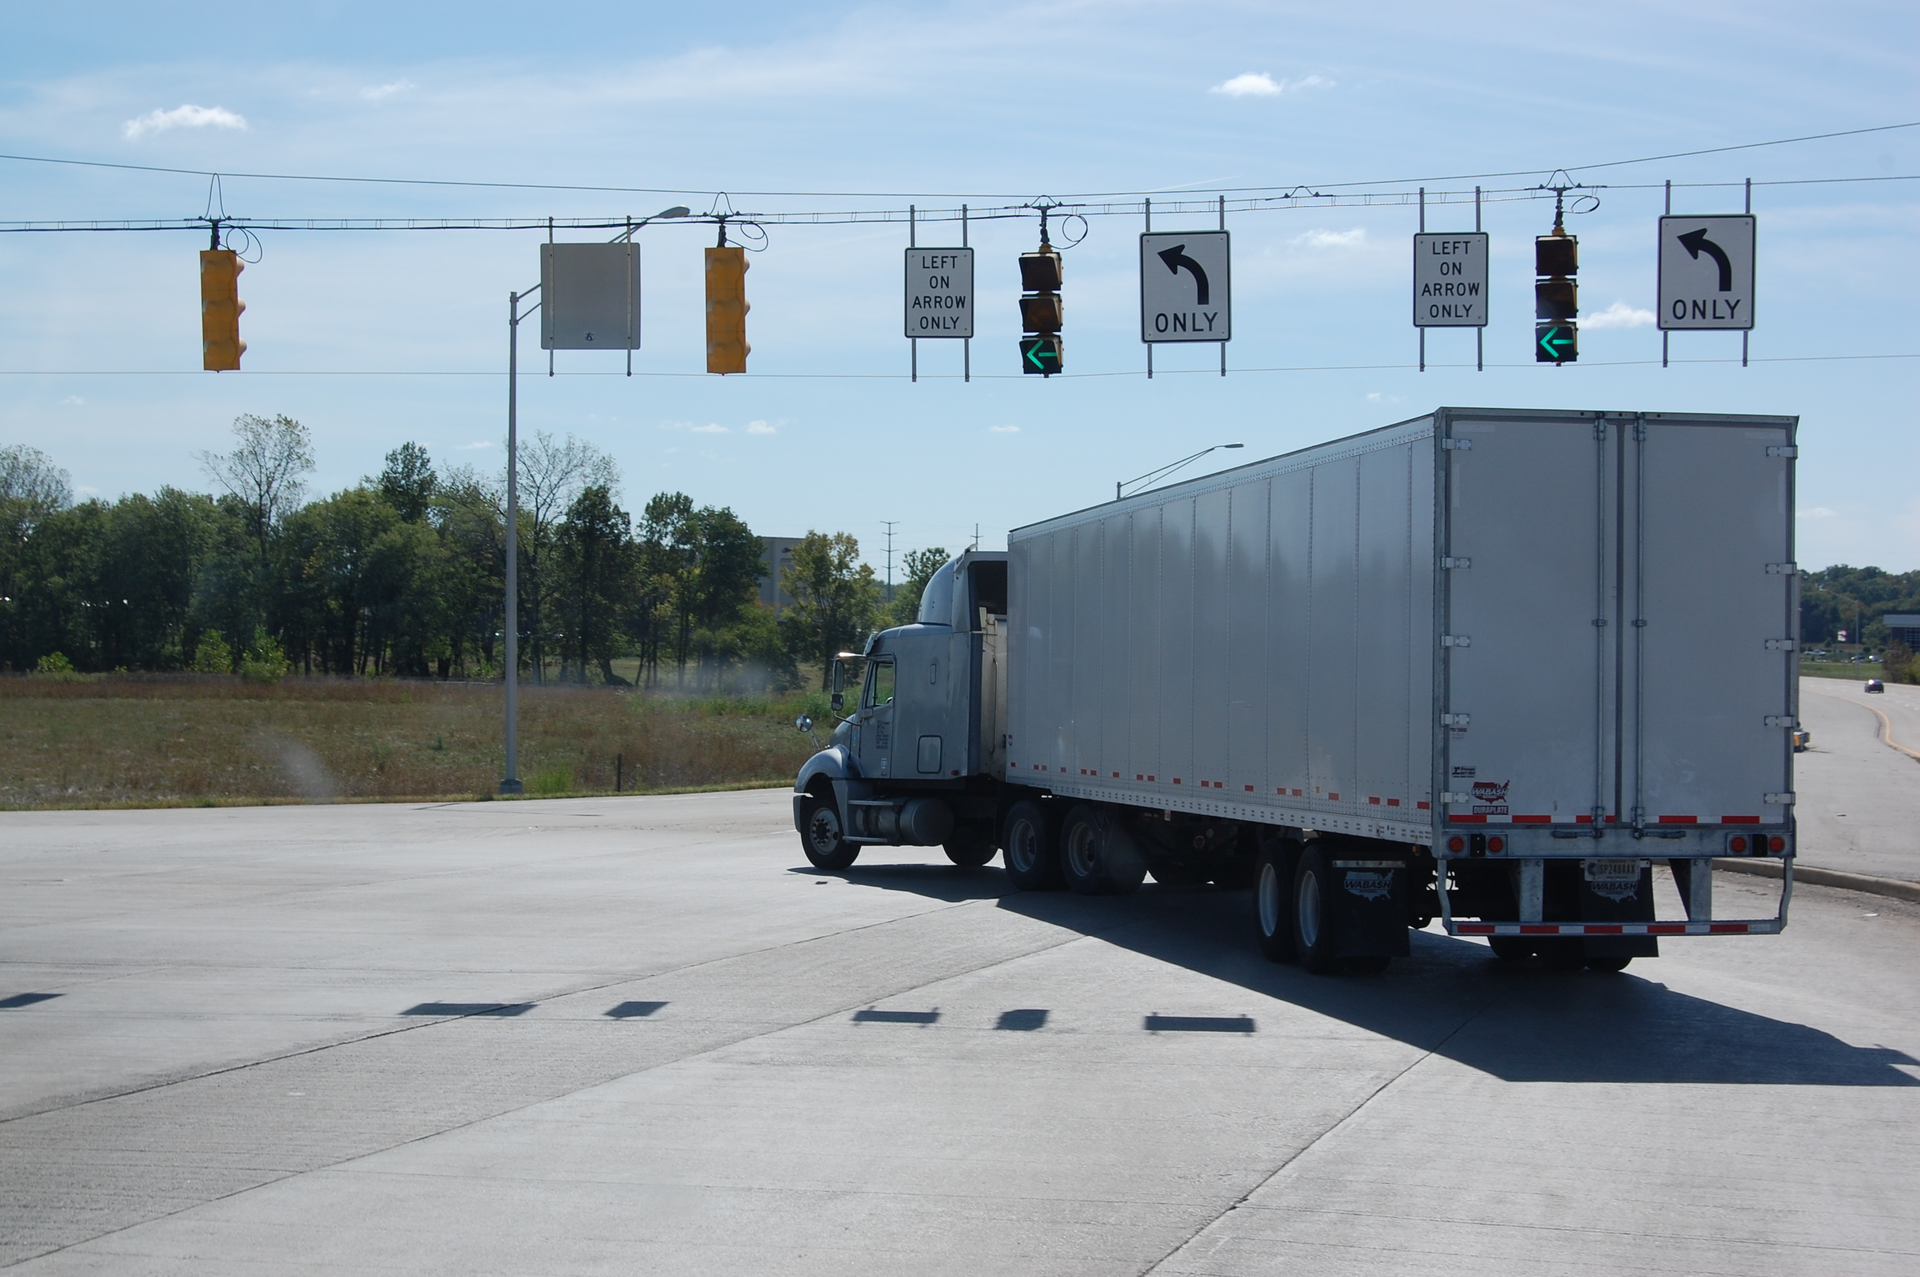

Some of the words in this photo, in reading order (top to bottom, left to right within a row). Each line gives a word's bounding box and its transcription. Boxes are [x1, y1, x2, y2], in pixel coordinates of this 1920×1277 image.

[1432, 241, 1471, 255] LEFT
[922, 255, 958, 269] LEFT
[1440, 261, 1462, 276] ON
[929, 275, 950, 289] ON
[1421, 282, 1480, 297] ARROW
[912, 295, 966, 309] ARROW
[1672, 298, 1741, 320] ONLY
[1429, 304, 1473, 318] ONLY
[920, 316, 960, 330] ONLY
[1155, 311, 1218, 333] ONLY
[1472, 788, 1508, 796] WABASH
[1474, 806, 1508, 814] DURAPLATE
[1345, 880, 1391, 889] WABASH
[1592, 882, 1637, 891] WABASH
